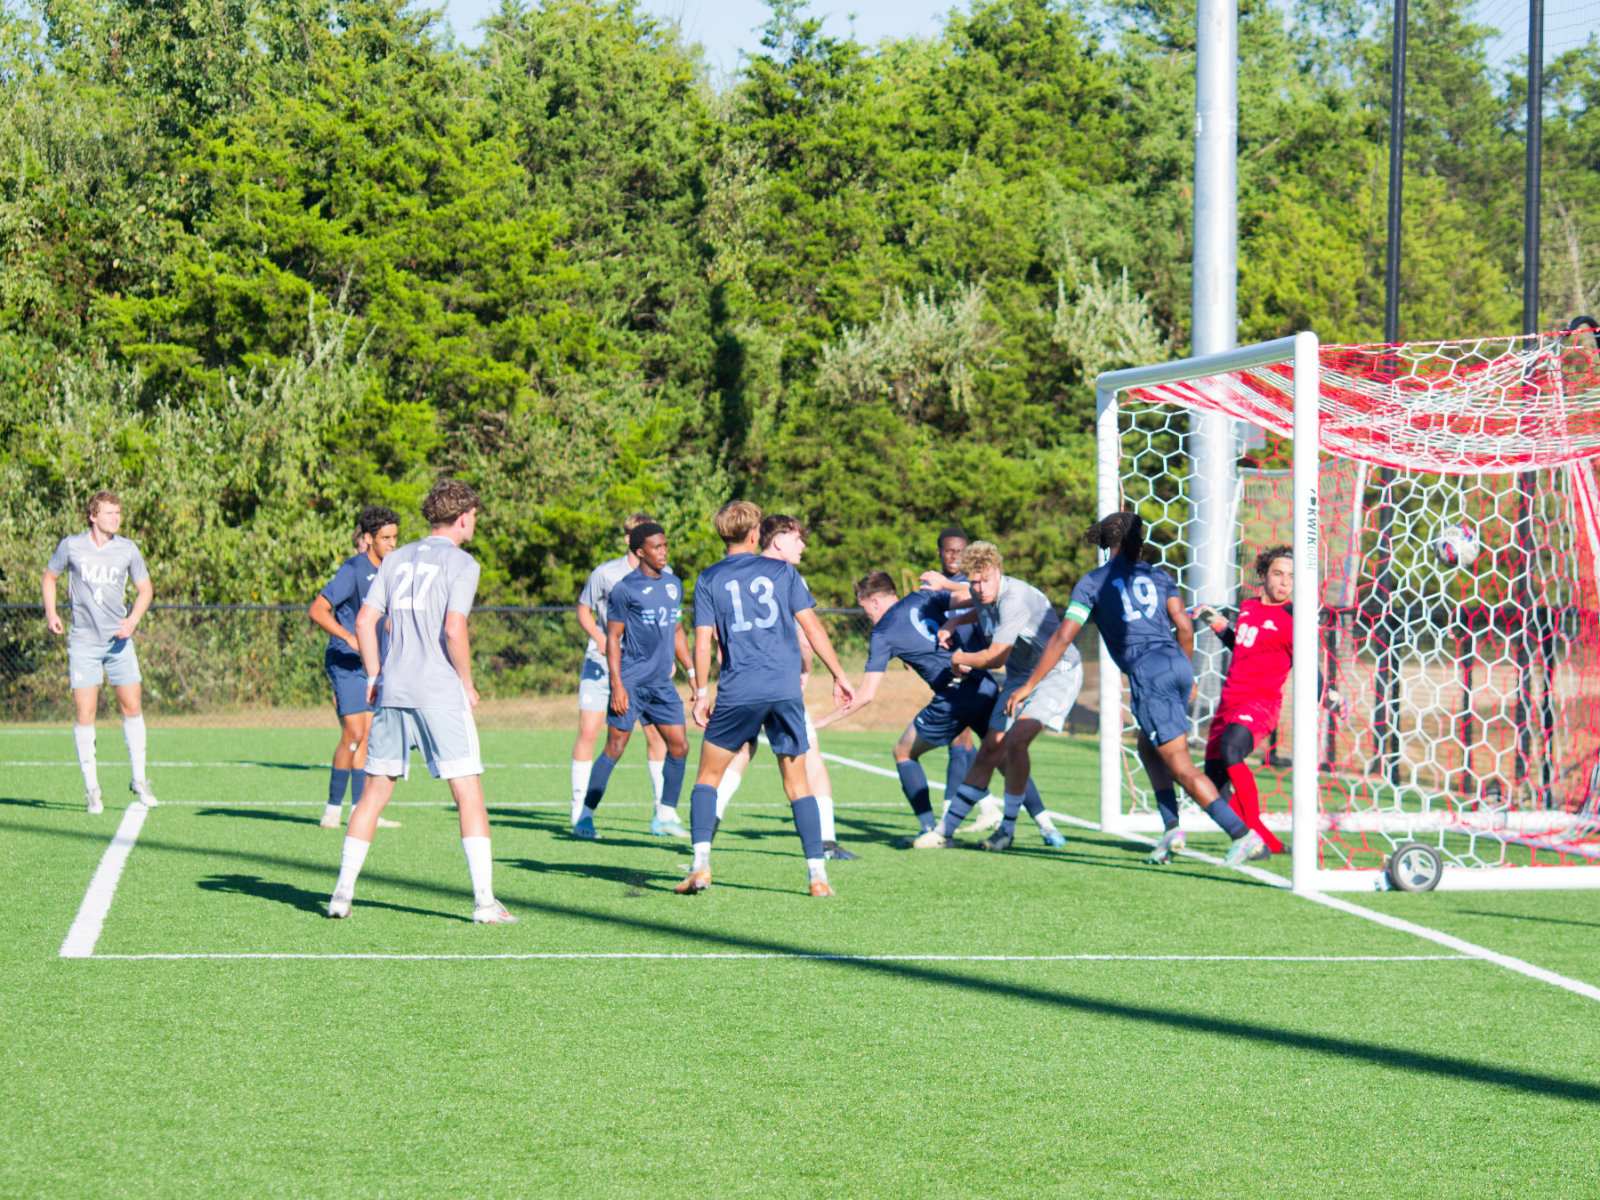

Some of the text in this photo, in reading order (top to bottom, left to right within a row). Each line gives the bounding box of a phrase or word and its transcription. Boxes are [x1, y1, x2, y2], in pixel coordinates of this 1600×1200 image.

[81, 563, 120, 584] MAC
[393, 561, 440, 611] 27
[658, 606, 669, 627] 2
[724, 576, 779, 632] 13
[1111, 576, 1159, 622] 19
